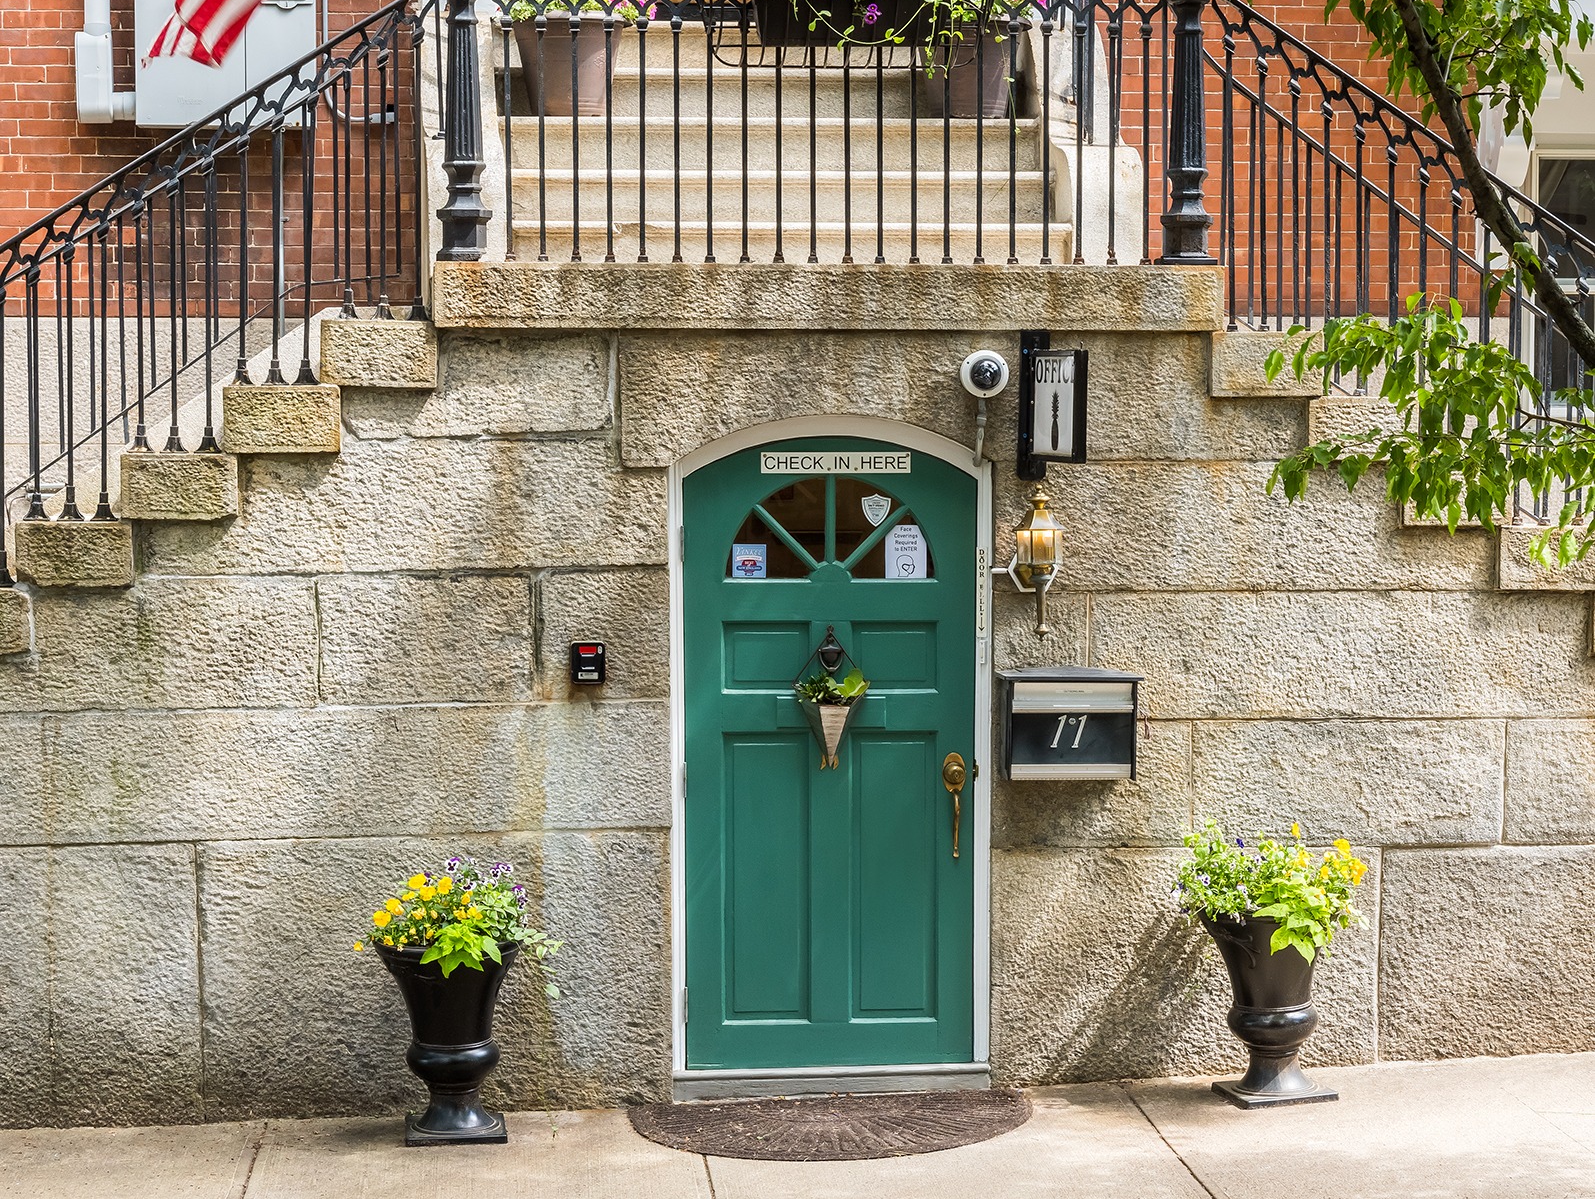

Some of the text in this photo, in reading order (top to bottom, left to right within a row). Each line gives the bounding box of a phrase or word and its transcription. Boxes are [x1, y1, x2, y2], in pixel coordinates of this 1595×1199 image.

[764, 456, 908, 470] CHECK IN HERE
[1050, 714, 1087, 749] 11
